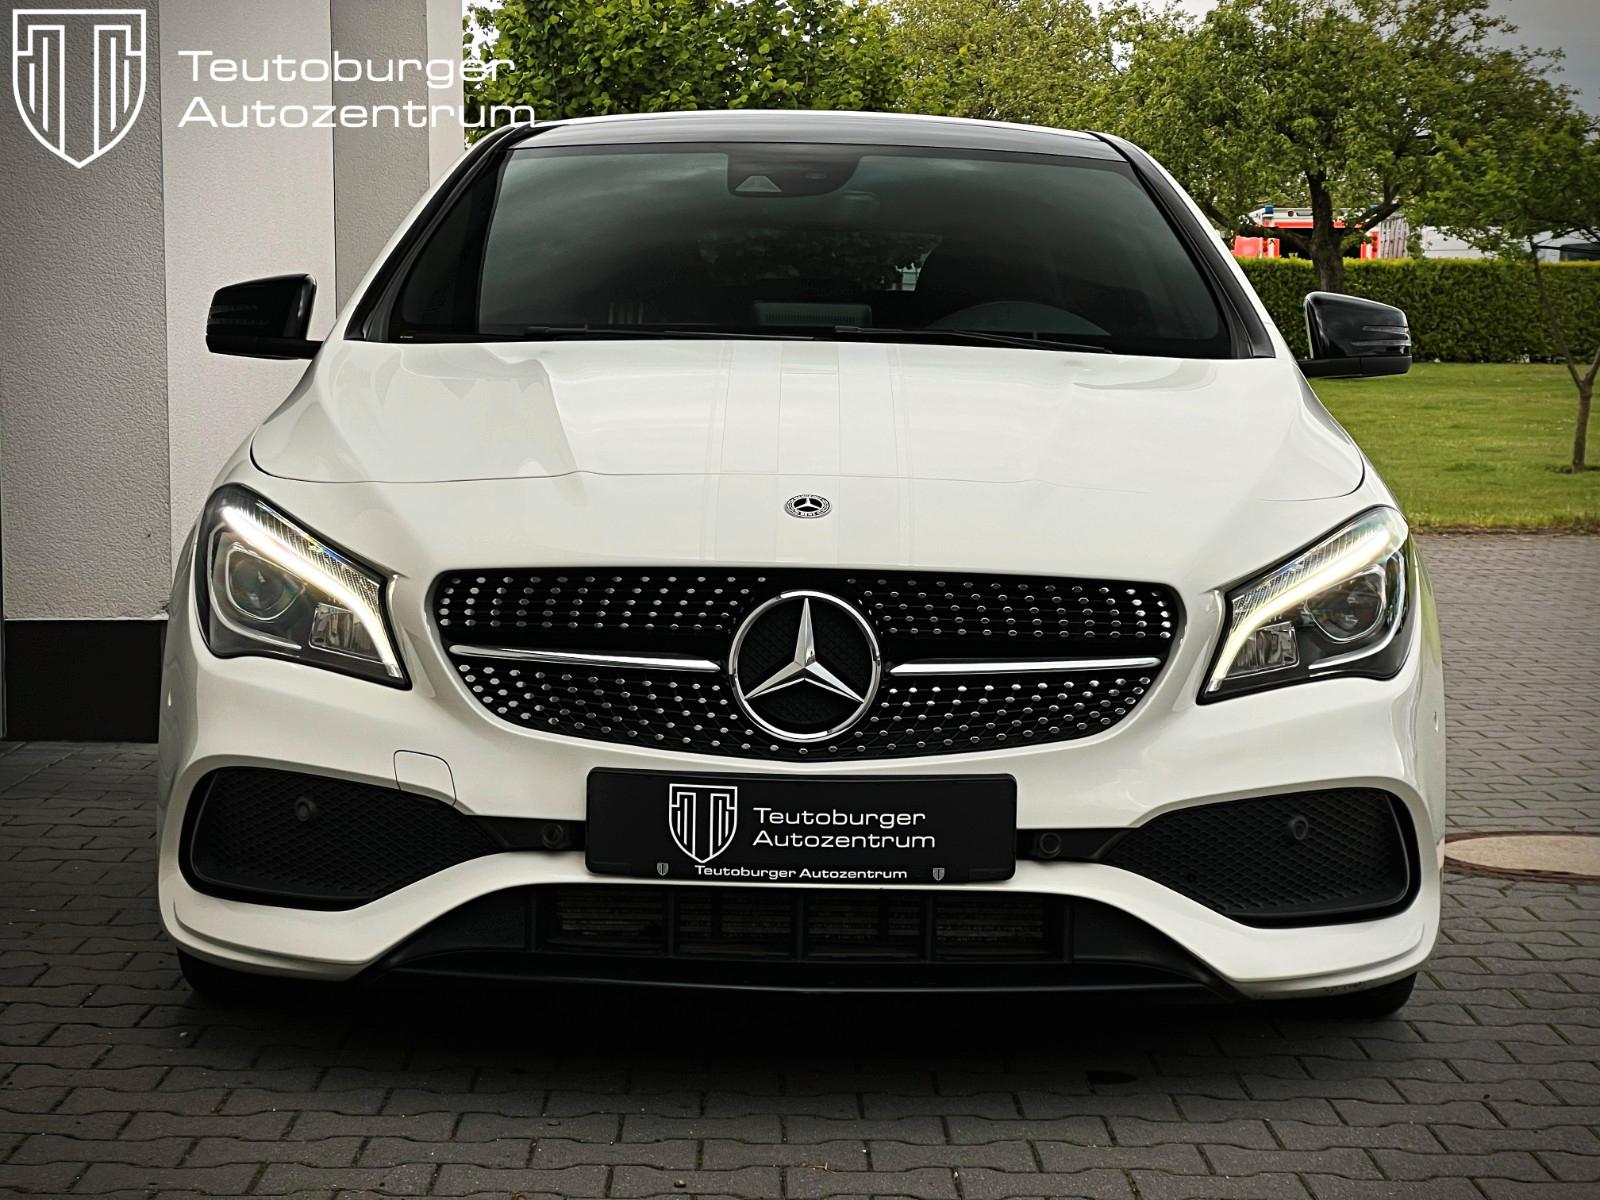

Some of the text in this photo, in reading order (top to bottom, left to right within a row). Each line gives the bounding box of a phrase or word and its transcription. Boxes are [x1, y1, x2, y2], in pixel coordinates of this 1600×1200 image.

[752, 807, 926, 828] Teutoburger
[752, 830, 936, 848] Autozentrum
[694, 865, 908, 880] Teutoburger Autozentrum
